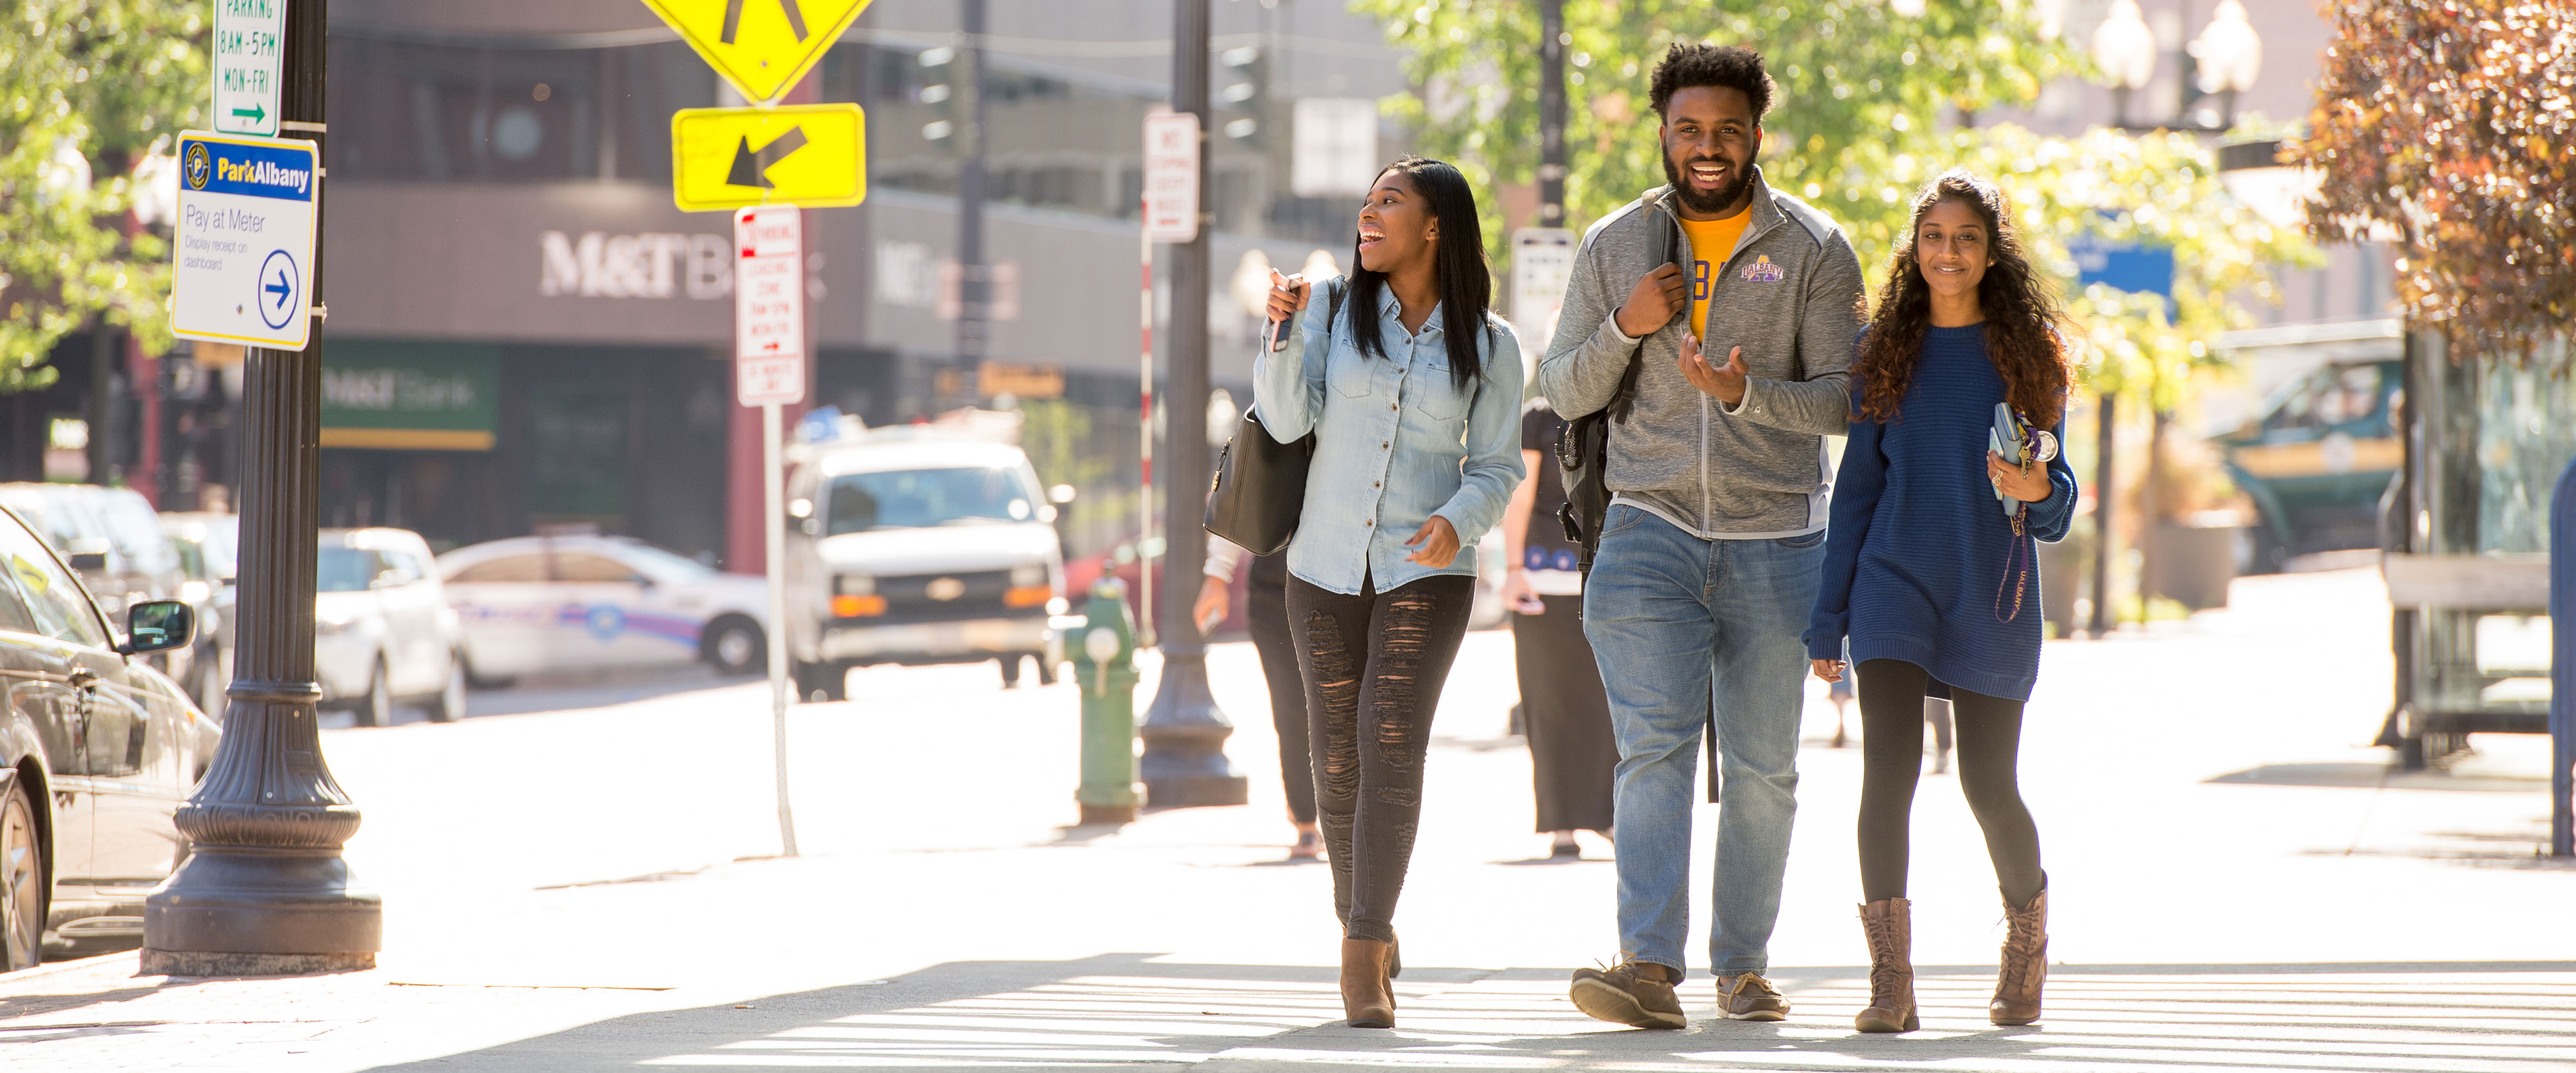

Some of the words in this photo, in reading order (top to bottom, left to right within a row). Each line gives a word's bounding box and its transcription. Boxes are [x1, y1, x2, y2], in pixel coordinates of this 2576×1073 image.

[227, 0, 272, 19] PARKING
[224, 68, 269, 94] MON-FRI
[218, 157, 309, 194] ParkAlbany
[186, 204, 210, 233] Pay
[213, 208, 225, 229] at
[229, 208, 265, 233] Meter
[185, 234, 211, 253] Display
[212, 240, 236, 254] receipt
[238, 243, 247, 253] on
[184, 254, 223, 271] dashboard
[1743, 263, 1783, 279] UALBANY
[2014, 571, 2027, 611] UALBANY
